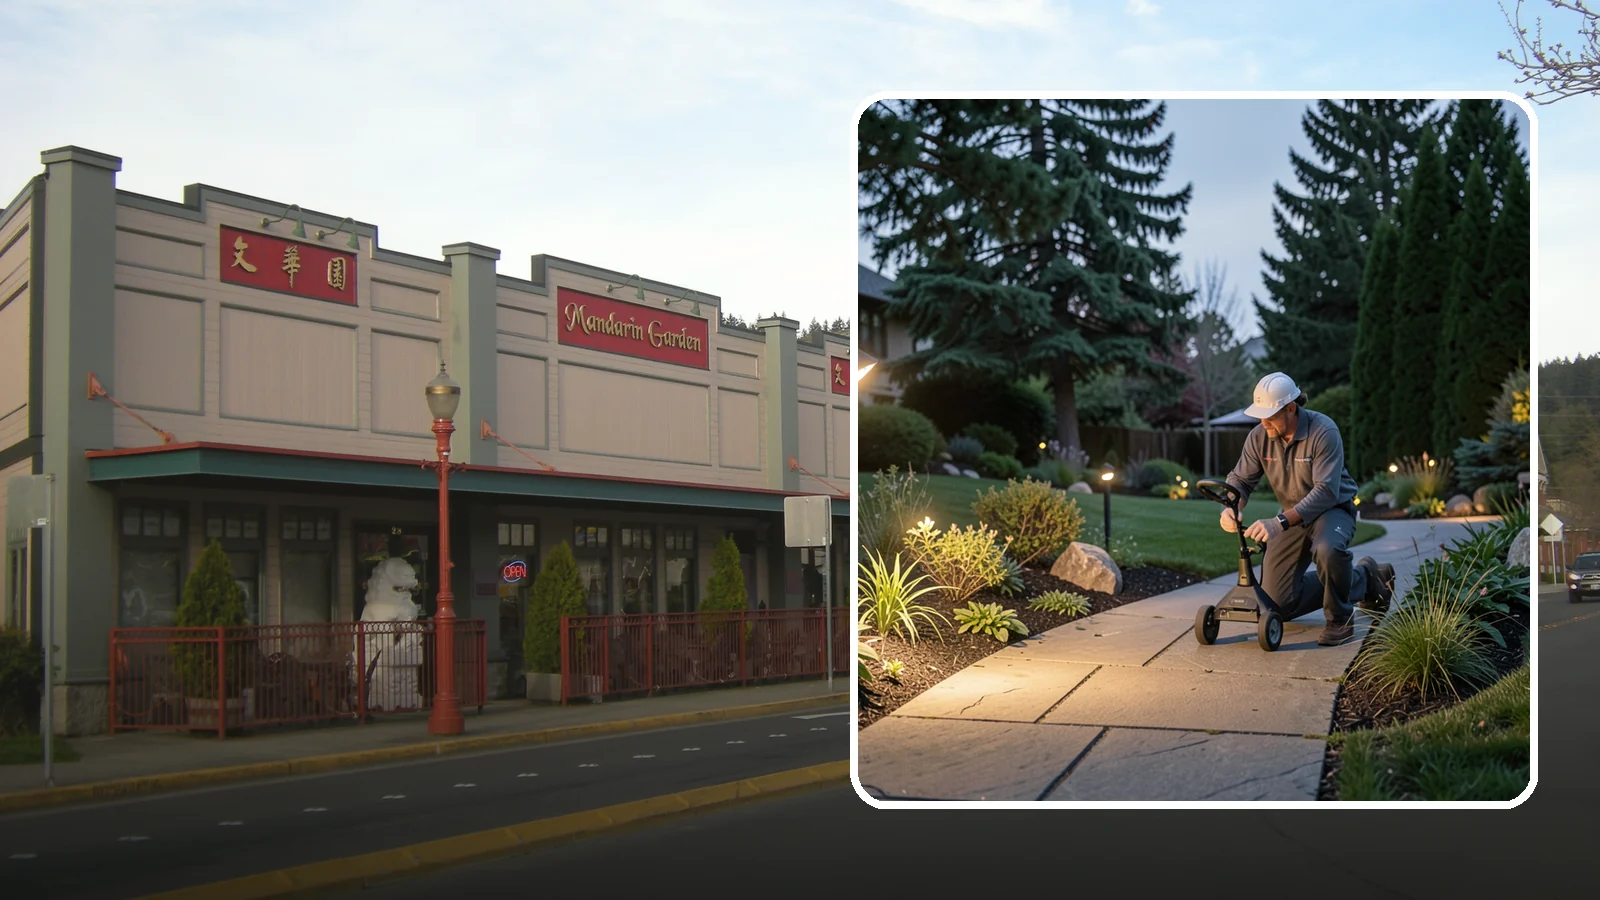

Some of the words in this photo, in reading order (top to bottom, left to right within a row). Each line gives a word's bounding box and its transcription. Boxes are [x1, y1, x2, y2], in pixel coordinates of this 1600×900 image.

[231, 236, 346, 291] 文華園
[564, 302, 644, 341] Mandarin
[648, 320, 701, 352] Garden
[503, 566, 526, 577] OPEN
